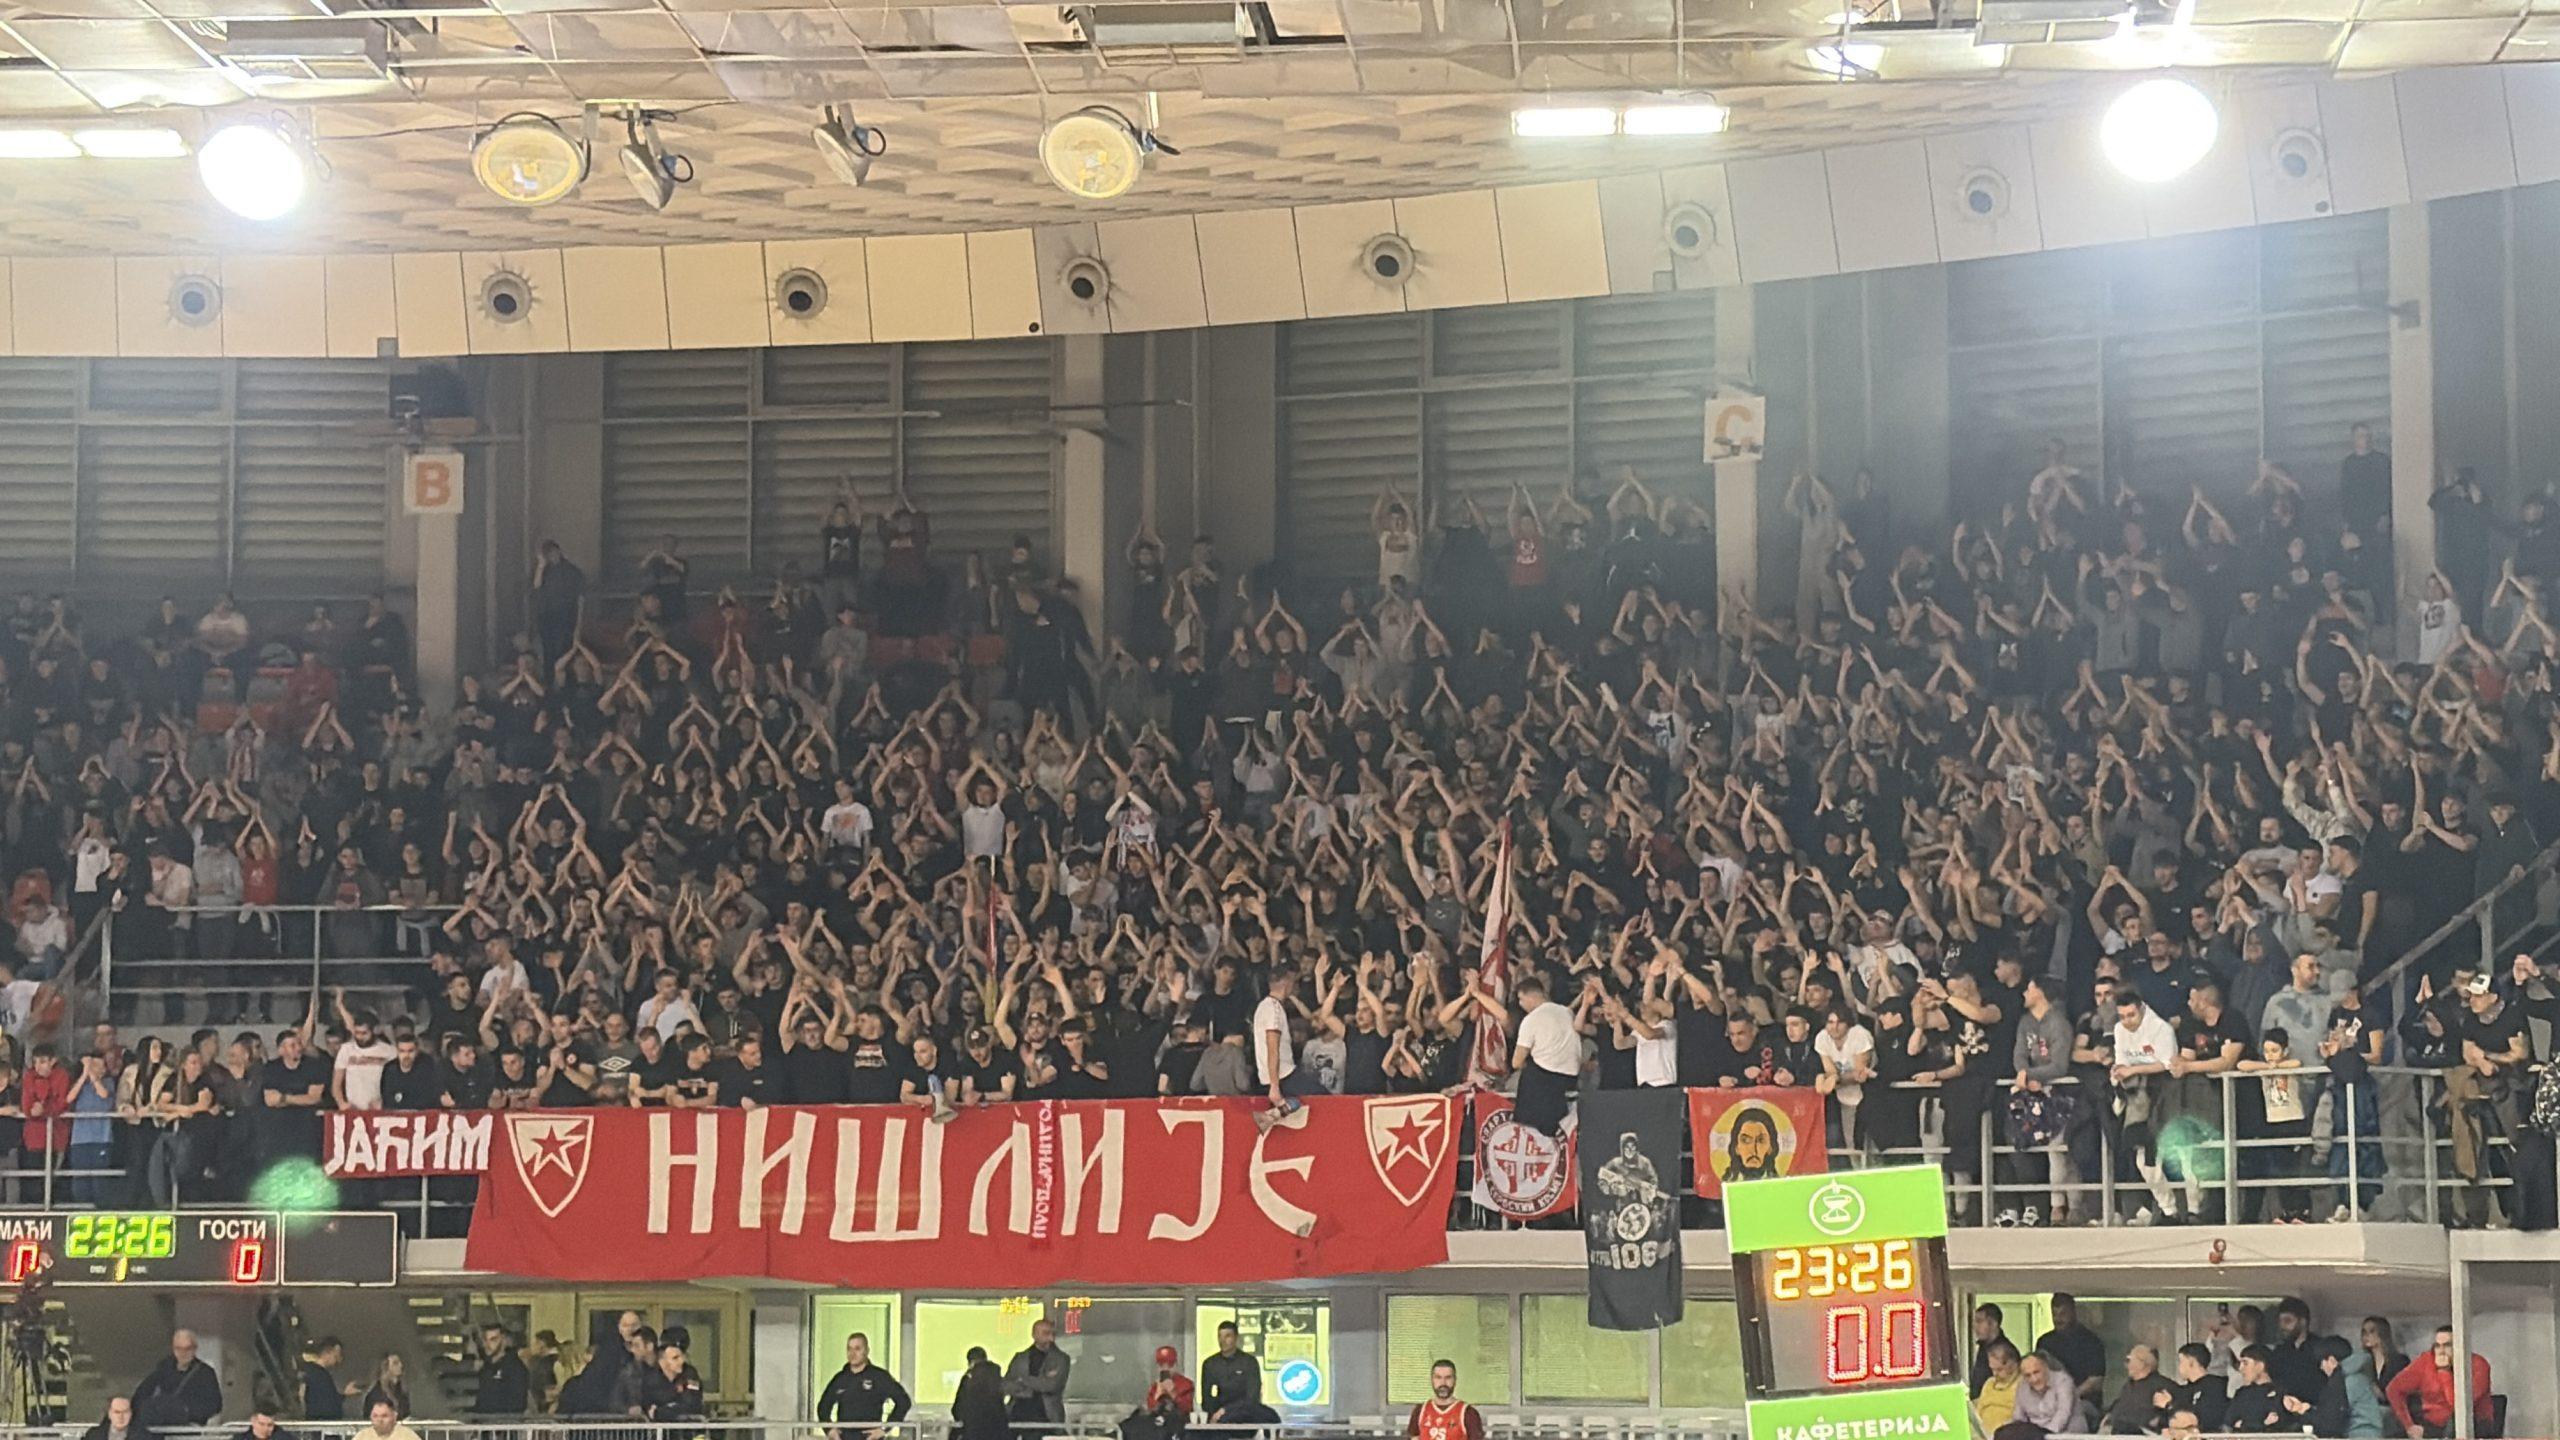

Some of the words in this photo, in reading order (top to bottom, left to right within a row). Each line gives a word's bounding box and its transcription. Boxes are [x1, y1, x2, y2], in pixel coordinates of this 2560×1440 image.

[1714, 404, 1755, 450] C
[415, 461, 451, 507] B
[69, 1215, 173, 1256] 23:26
[200, 1219, 267, 1241] ГОСТИ
[235, 1242, 262, 1283] 0
[1773, 1240, 1914, 1300] 23:26
[1827, 1301, 1925, 1384] 0.0
[1776, 1413, 1950, 1440] КАФЕТЕРИЈА
